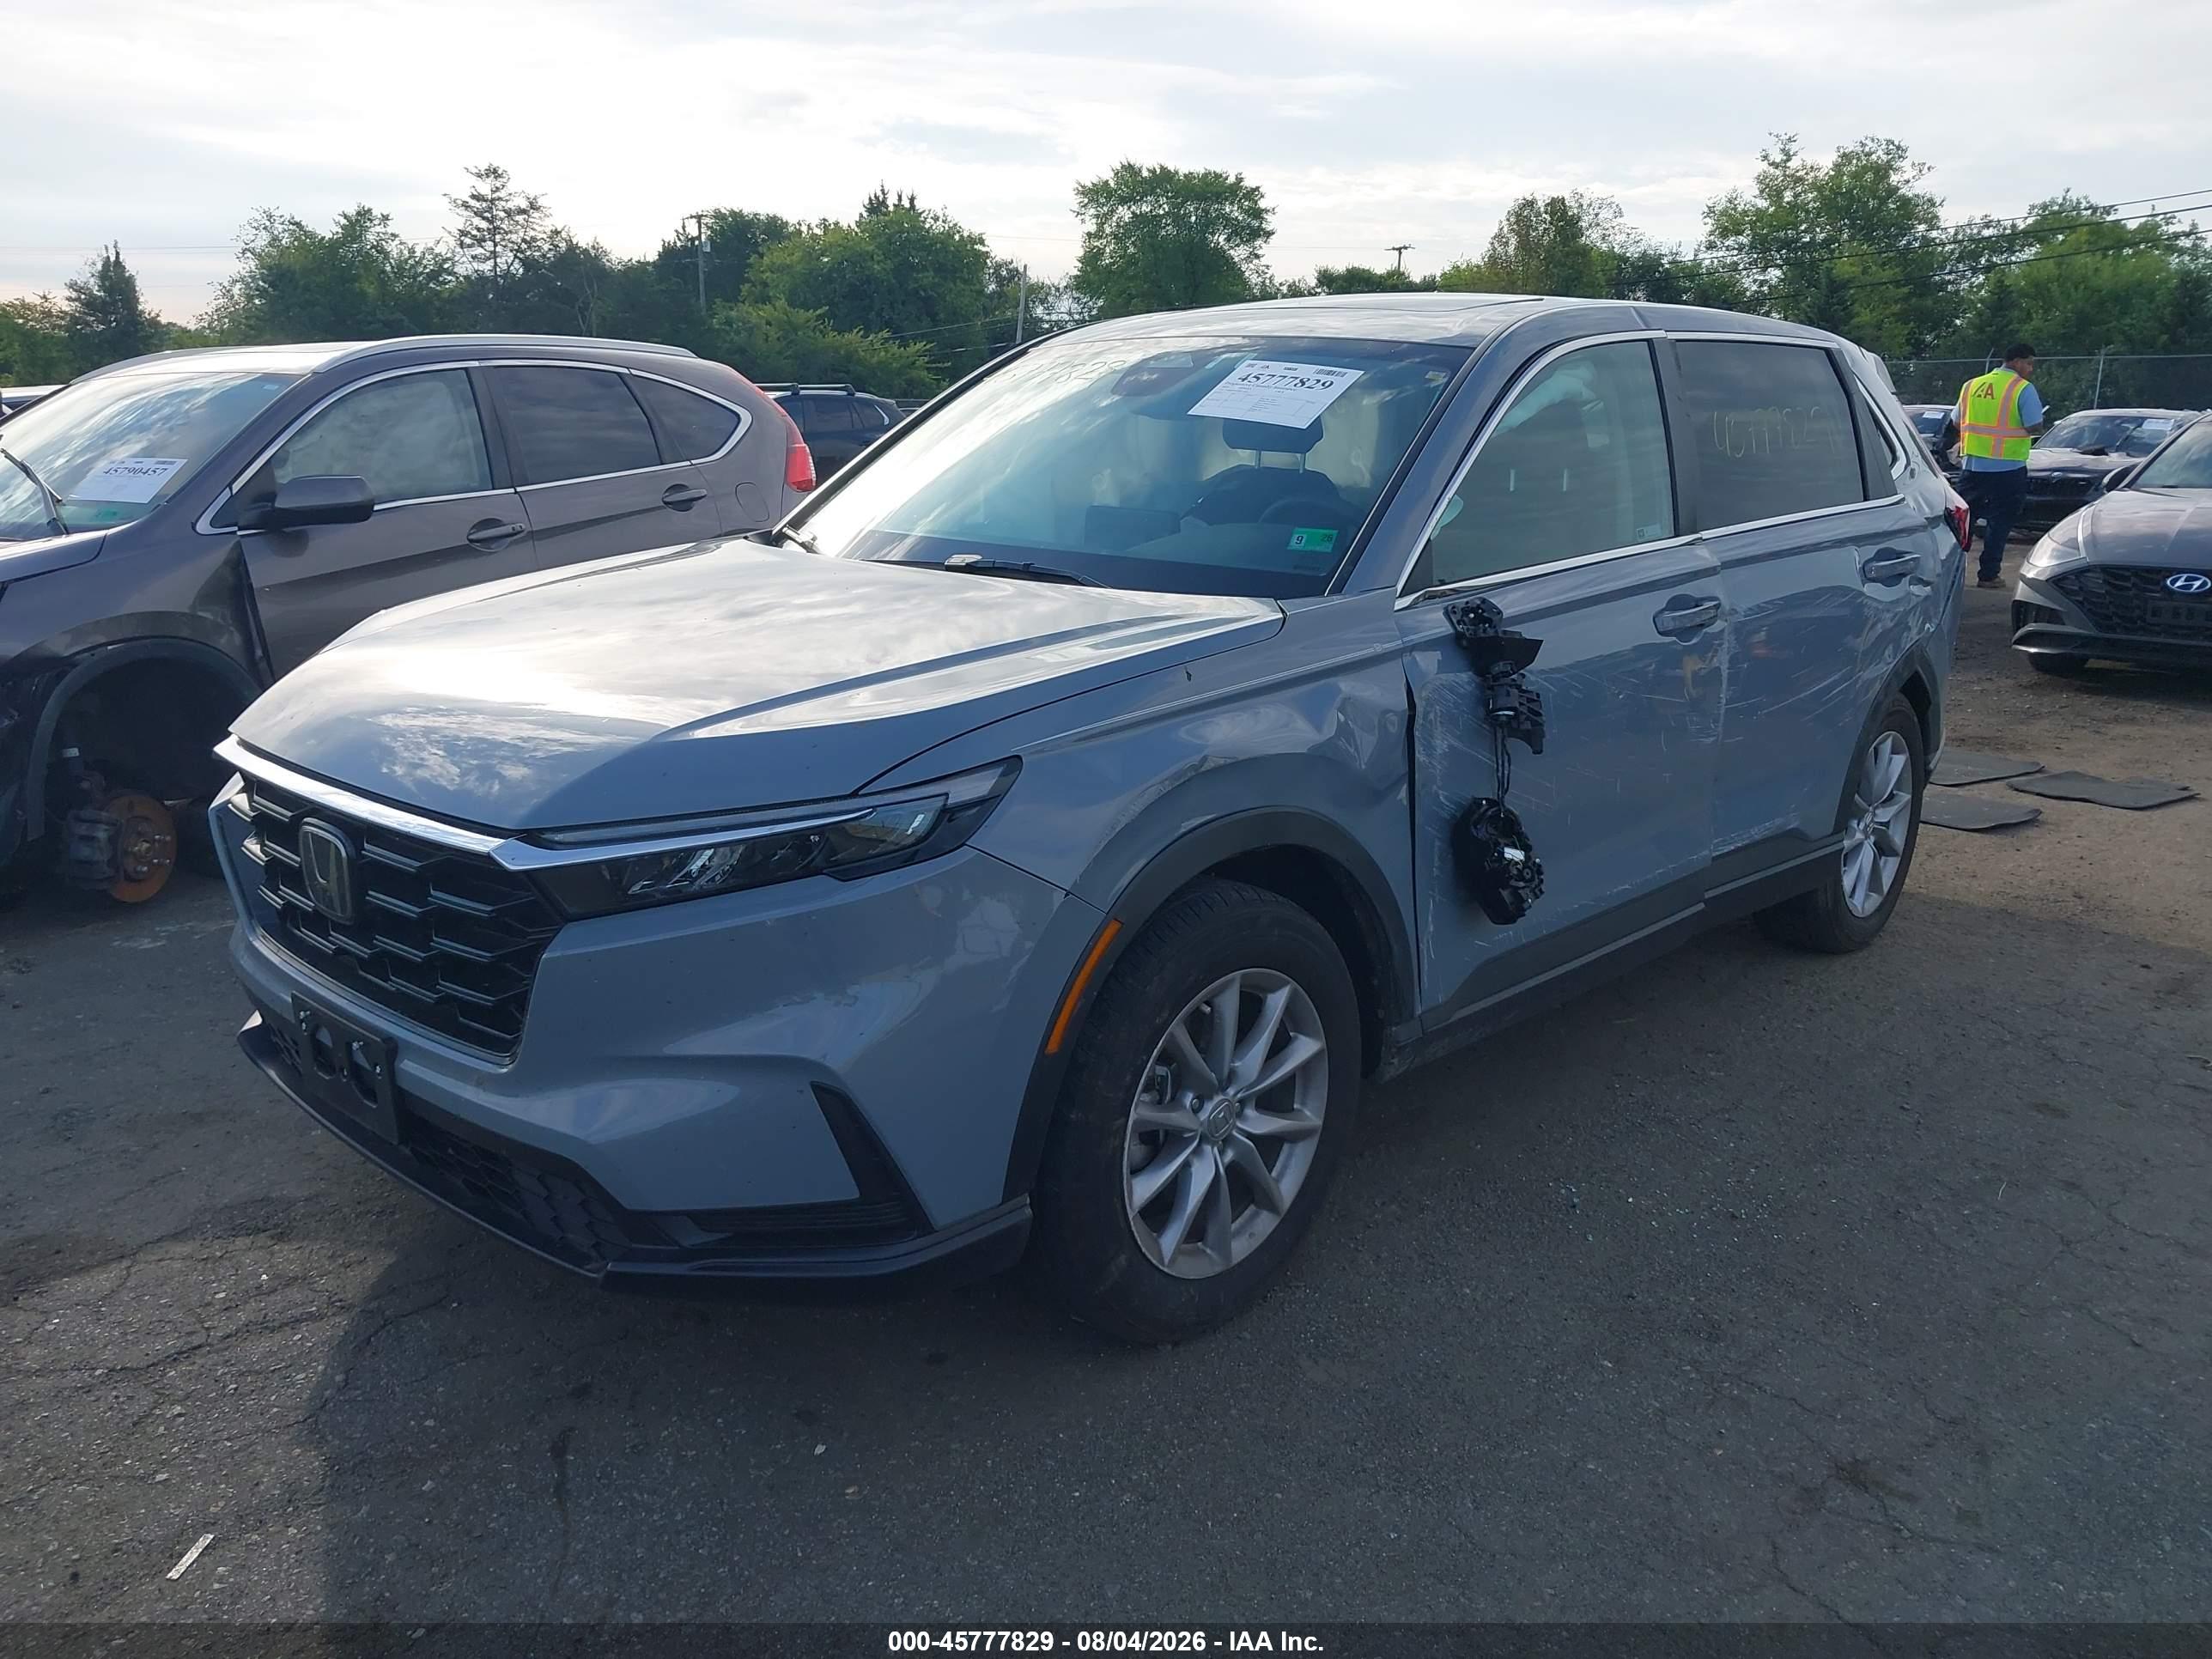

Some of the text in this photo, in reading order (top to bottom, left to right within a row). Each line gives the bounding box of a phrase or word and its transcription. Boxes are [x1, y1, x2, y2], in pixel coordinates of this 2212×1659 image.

[1237, 372, 1334, 391] 45777829
[103, 466, 170, 477] 45790457
[1295, 535, 1304, 544] 9
